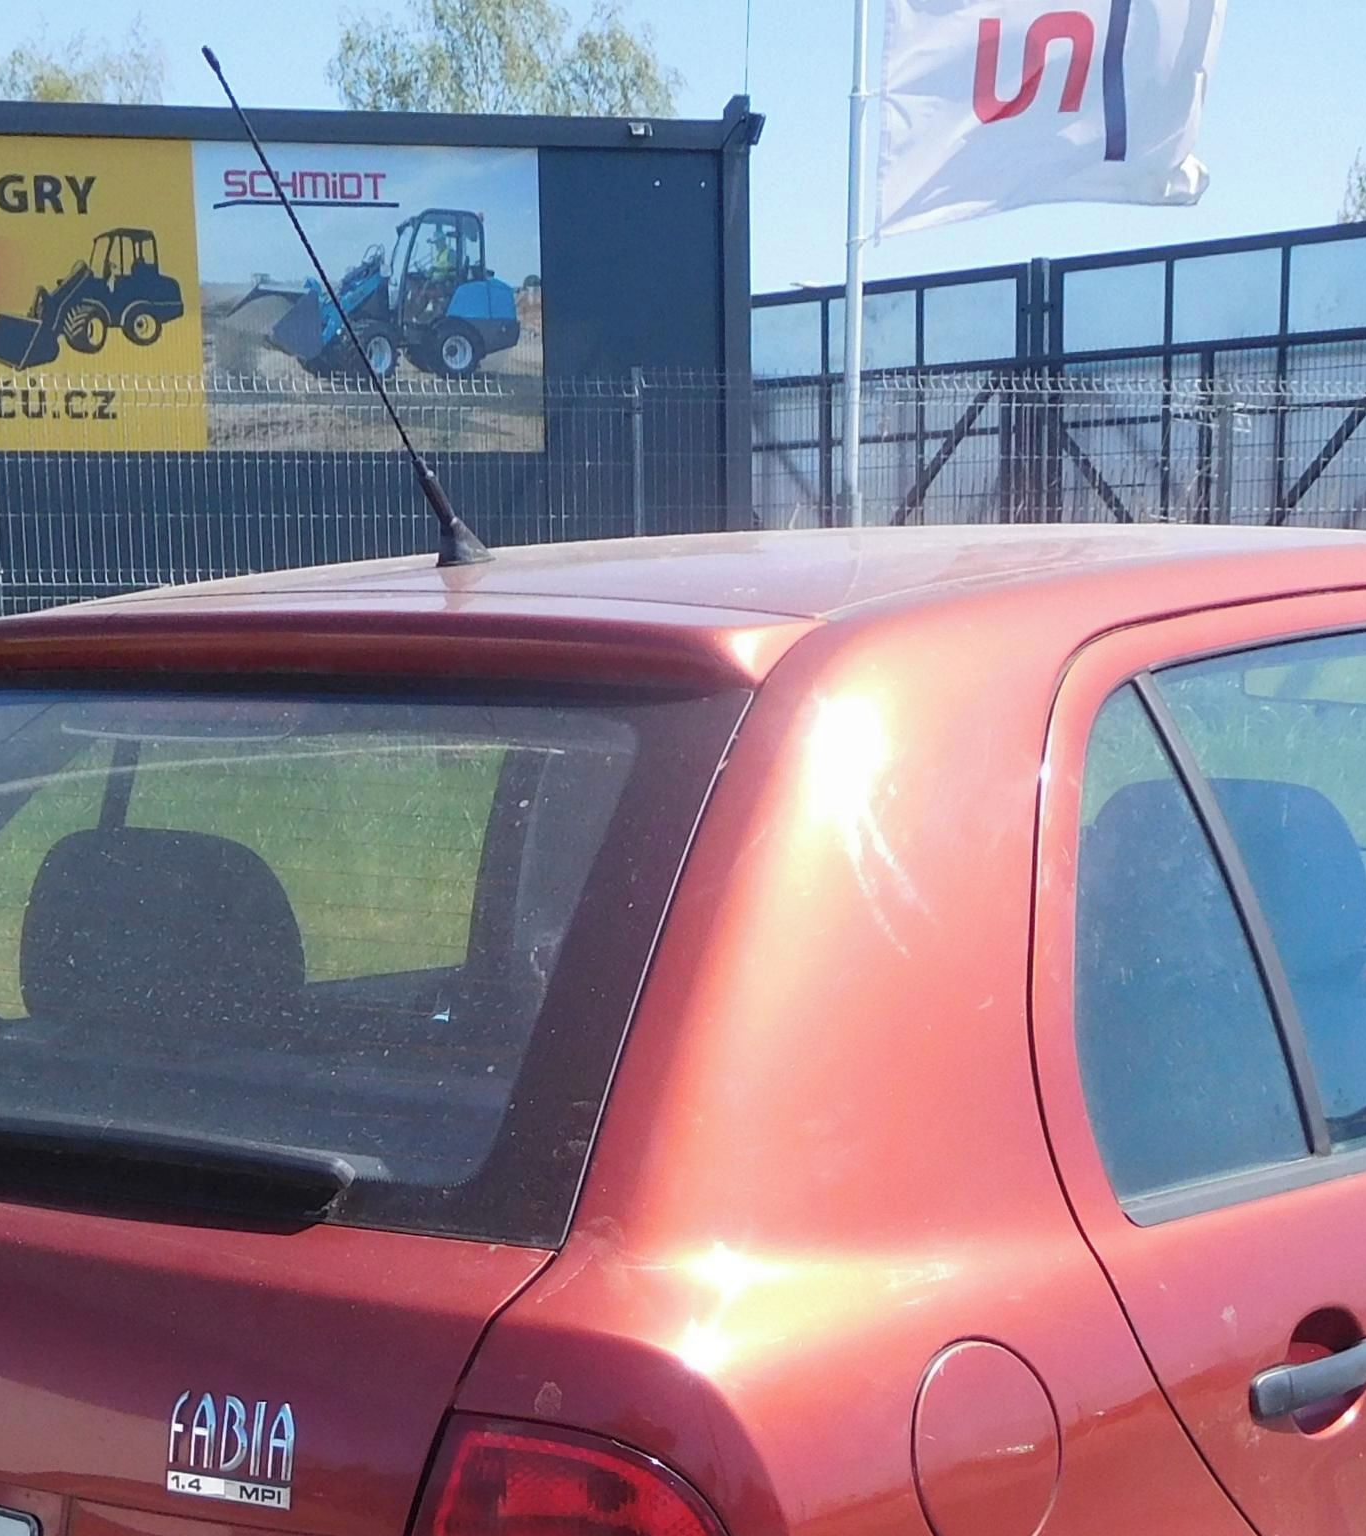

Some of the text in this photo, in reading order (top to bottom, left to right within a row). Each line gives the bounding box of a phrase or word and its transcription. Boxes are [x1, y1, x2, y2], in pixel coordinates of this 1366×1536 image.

[169, 1390, 295, 1482] FABIA
[171, 1475, 282, 1505] 1.4 MPI
